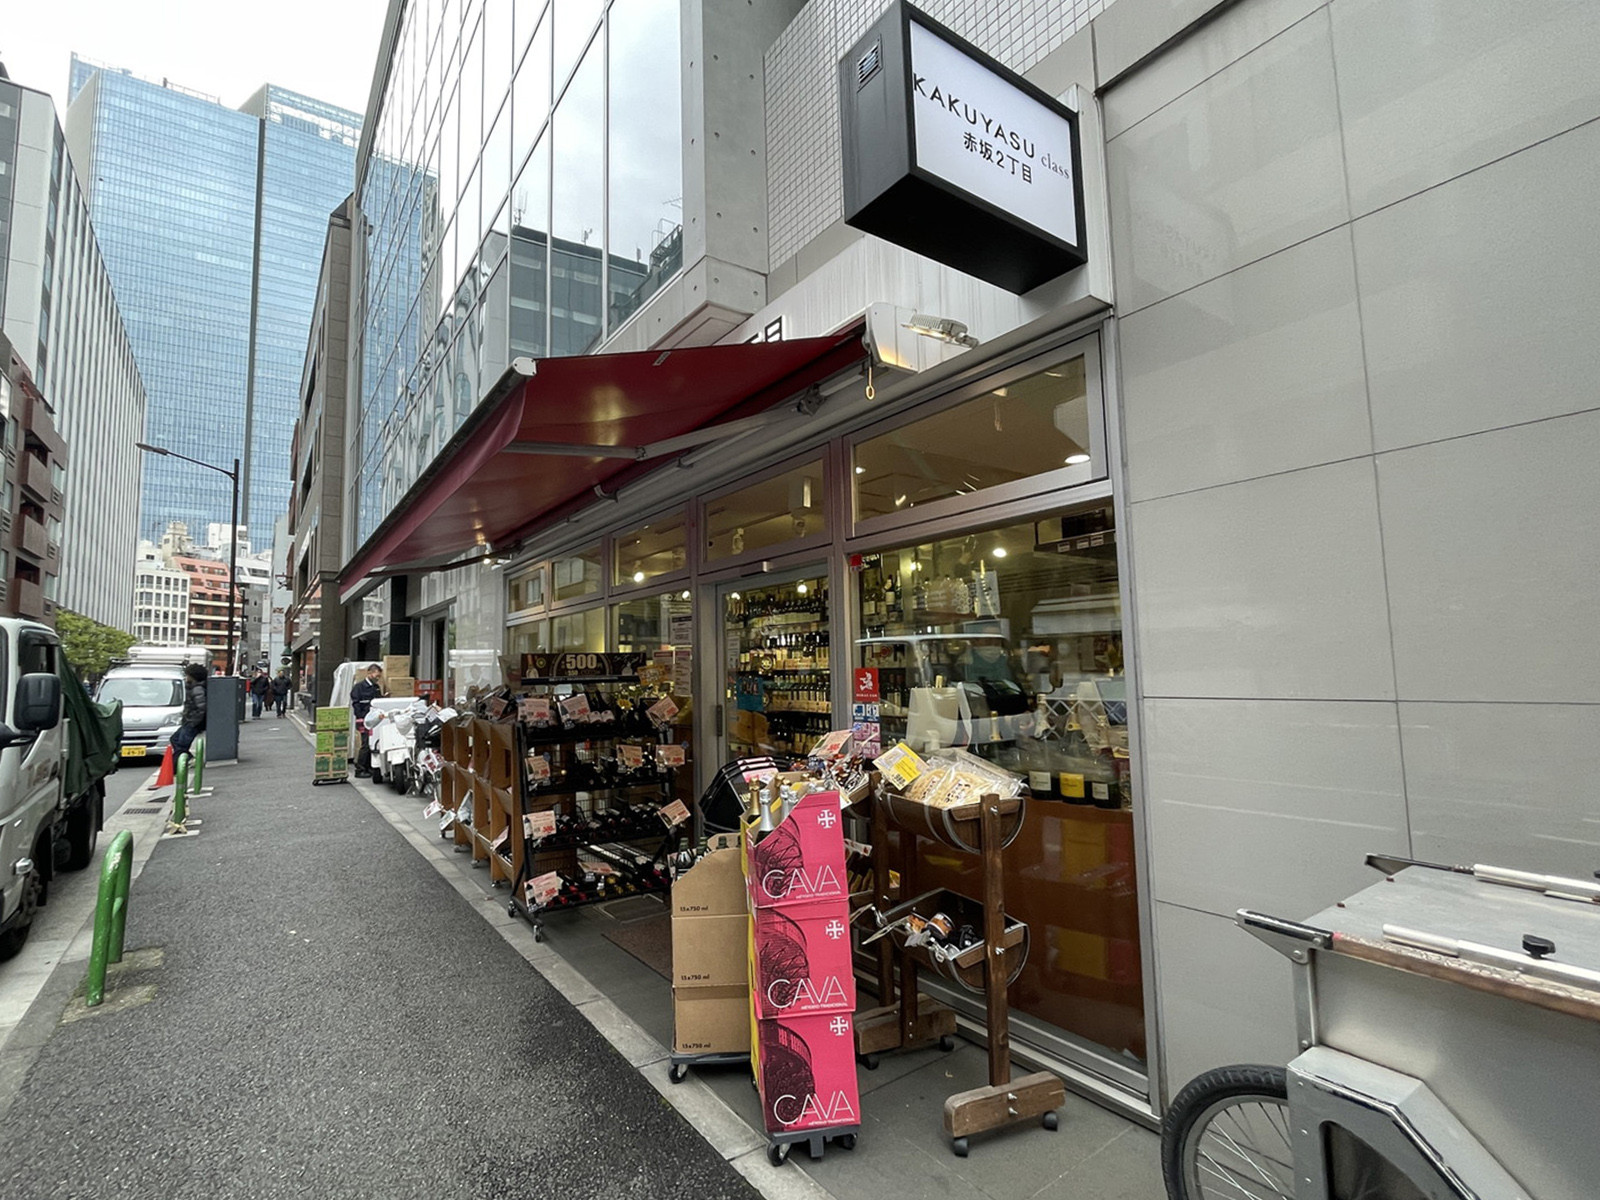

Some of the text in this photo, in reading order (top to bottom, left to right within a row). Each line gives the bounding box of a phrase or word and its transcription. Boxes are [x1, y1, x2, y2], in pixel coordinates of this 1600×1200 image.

[913, 73, 1070, 179] KAKUYASU class
[963, 131, 1033, 184] 赤坂2丁目
[565, 654, 598, 669] 500
[762, 865, 841, 899] CAVA
[767, 976, 848, 1009] CAVA
[773, 1090, 855, 1125] CAVA
